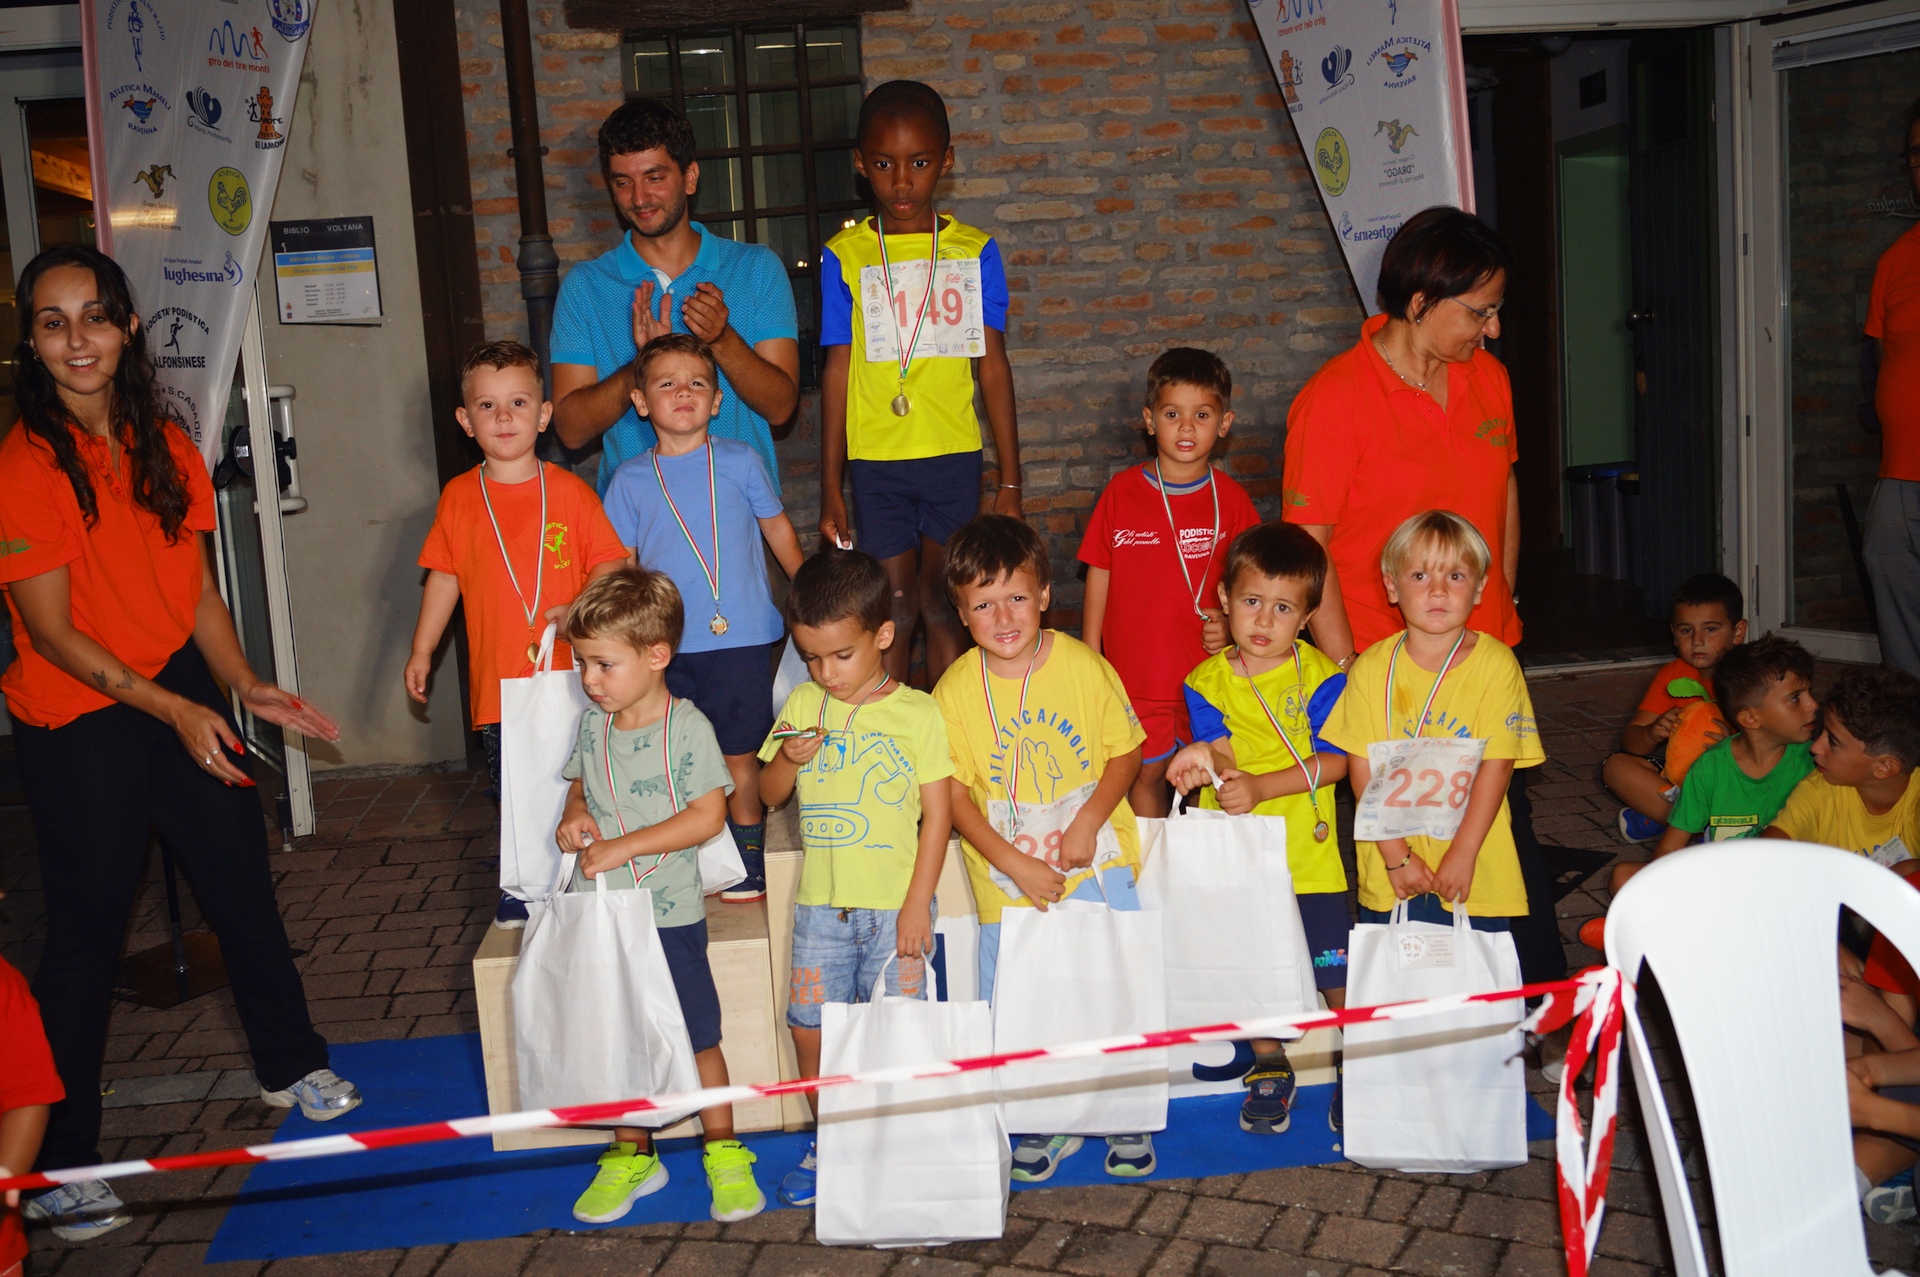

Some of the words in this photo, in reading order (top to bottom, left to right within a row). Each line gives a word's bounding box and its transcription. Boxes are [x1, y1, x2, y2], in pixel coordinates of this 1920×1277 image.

[208, 57, 221, 67] giro
[223, 59, 234, 69] dei
[236, 61, 247, 71] tre
[249, 64, 270, 74] monti
[109, 84, 141, 102] ATLETICA
[143, 83, 172, 110] MAMELI
[127, 122, 158, 135] RAVENNA
[206, 130, 232, 144] Antonietta
[283, 227, 310, 235] BIBLIO
[326, 224, 364, 232] VOLTANA
[893, 287, 964, 328] 149
[171, 307, 210, 336] PODISTICA
[153, 356, 206, 369] ALFONSINESE
[1179, 528, 1217, 540] PODISTIC
[1183, 551, 1210, 560] RAVENNA
[1383, 767, 1473, 810] 228
